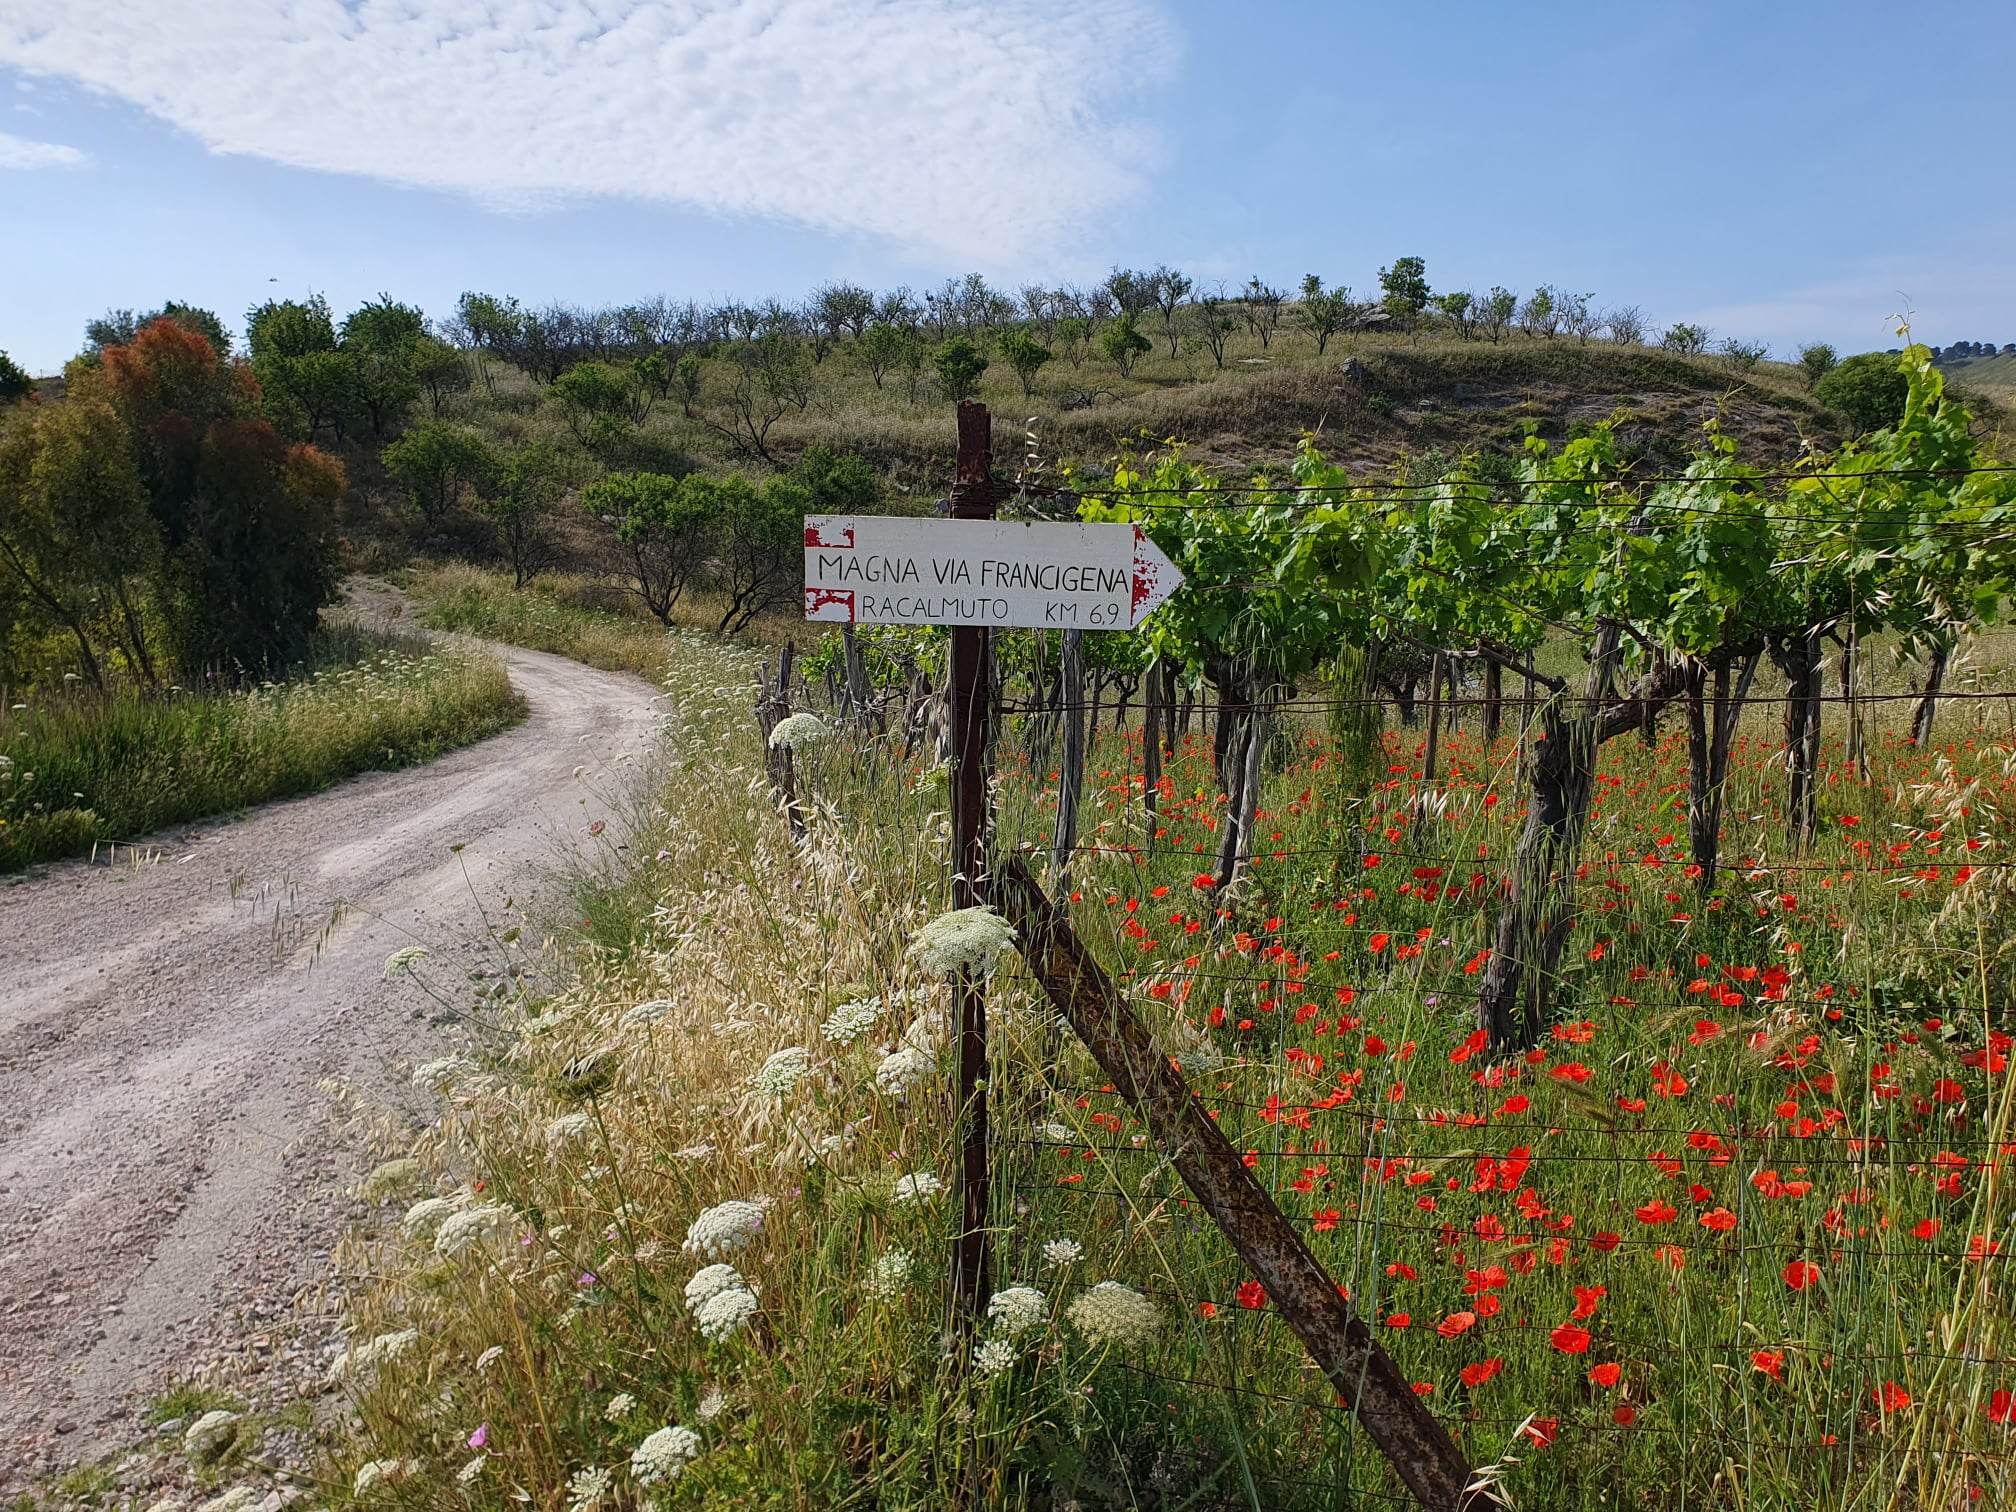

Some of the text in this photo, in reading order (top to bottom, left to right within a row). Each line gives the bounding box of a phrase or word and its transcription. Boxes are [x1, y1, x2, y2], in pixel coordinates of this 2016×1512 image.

[818, 554, 1129, 594] MAGNA VIA FRANCIGENA
[862, 595, 1009, 620] RACALMUTO
